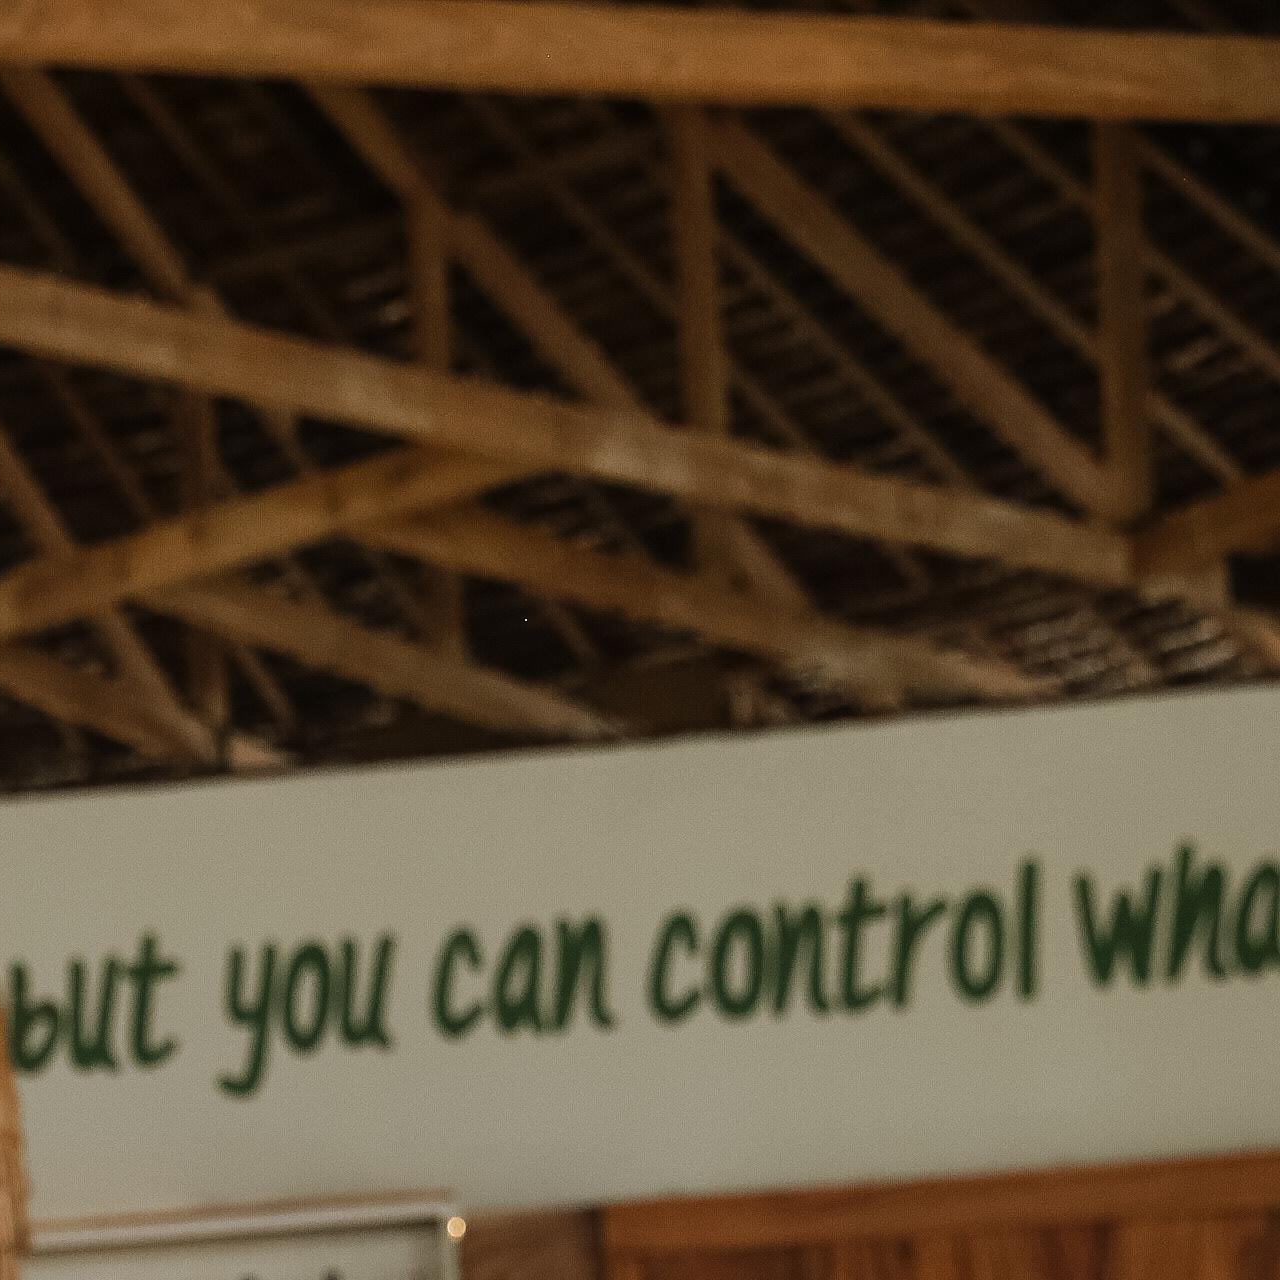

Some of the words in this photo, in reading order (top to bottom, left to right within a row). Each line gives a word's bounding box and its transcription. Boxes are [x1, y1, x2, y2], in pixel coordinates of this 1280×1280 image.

[8, 932, 180, 1076] but
[218, 932, 397, 1100] you
[429, 914, 616, 1041] can
[646, 857, 1044, 1026] control
[1072, 840, 1280, 991] wha
